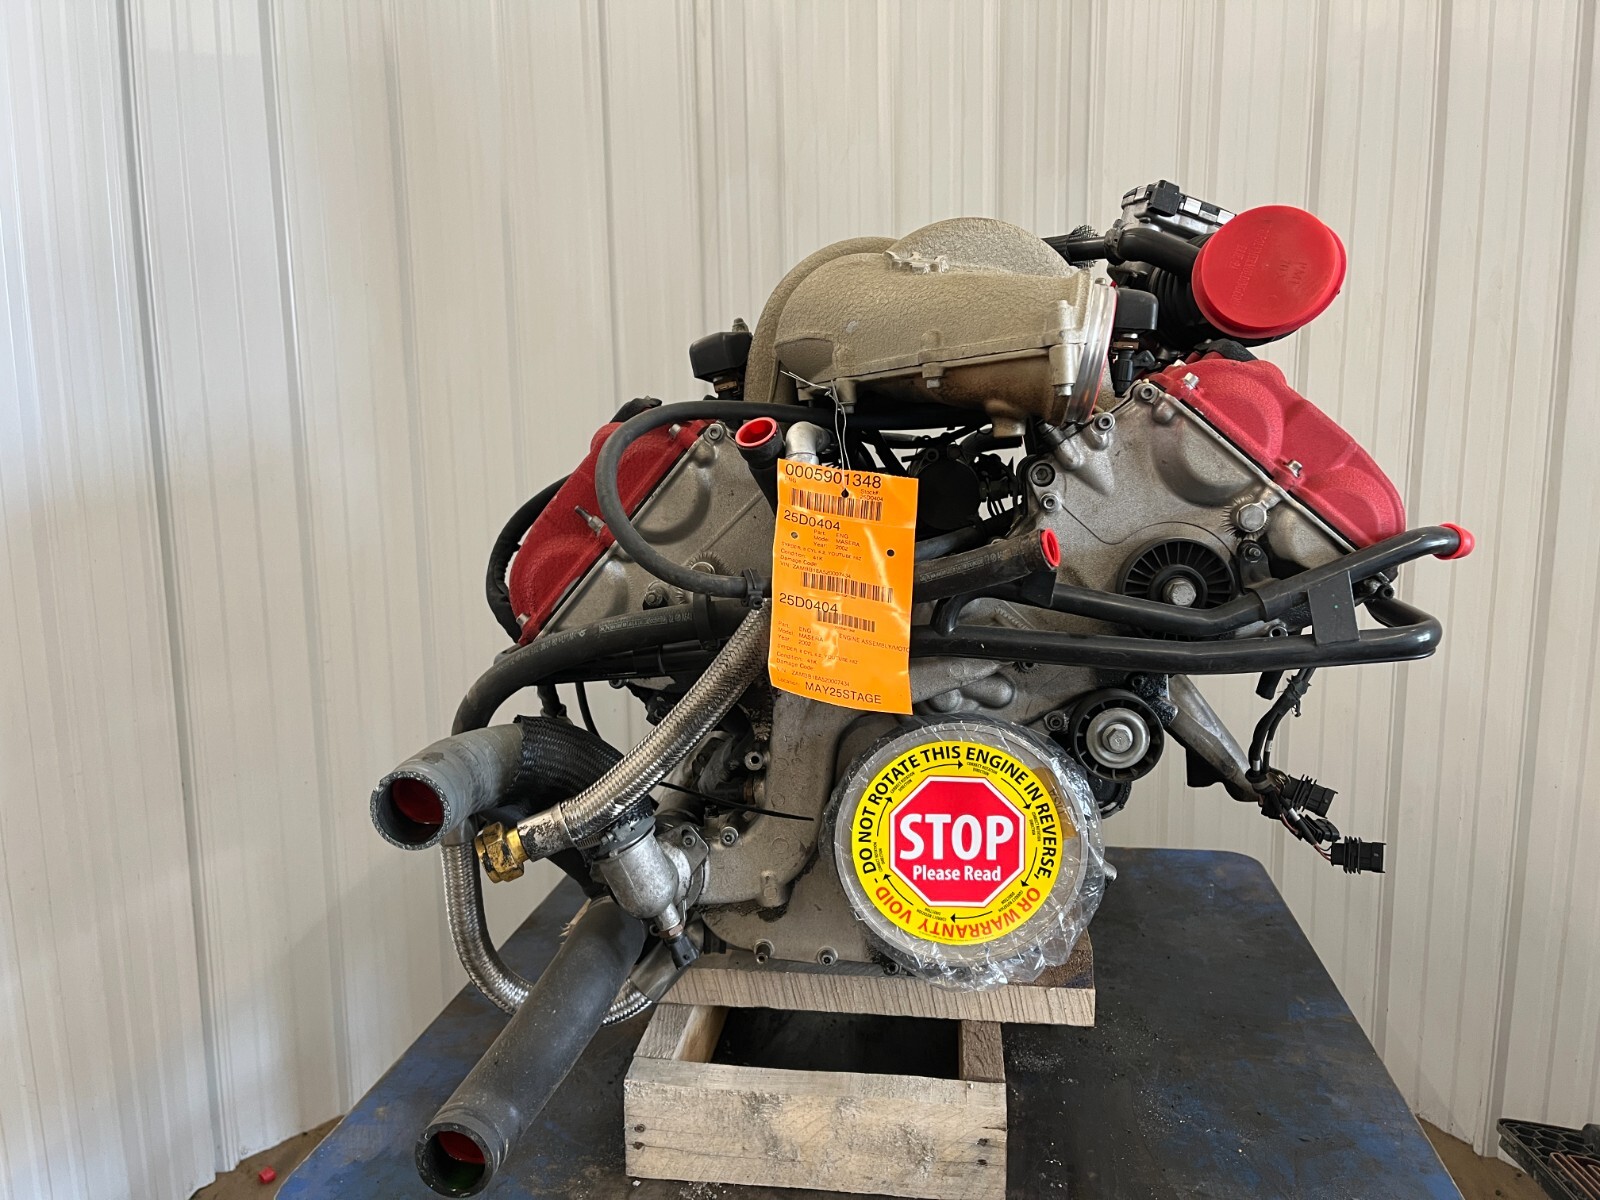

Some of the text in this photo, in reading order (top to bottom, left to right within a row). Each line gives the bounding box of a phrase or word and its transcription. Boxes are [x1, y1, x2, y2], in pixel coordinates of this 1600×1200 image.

[786, 464, 882, 488] 0005901348
[784, 510, 840, 531] 25D0404
[779, 593, 838, 613] 25D0404
[805, 682, 882, 704] MAY25STAGE
[920, 746, 960, 763] THIS
[966, 747, 1029, 785] ENGINE
[873, 754, 921, 806] ROTATE
[1024, 781, 1044, 802] IN
[859, 806, 876, 843] NOT
[899, 813, 1014, 861] STOP
[1033, 804, 1057, 881] REVERSE,
[859, 848, 875, 875] DO
[913, 864, 1001, 882] Please Read
[875, 886, 913, 925] VOID
[1016, 887, 1041, 912] OR
[917, 912, 1021, 938] WARRANTY
